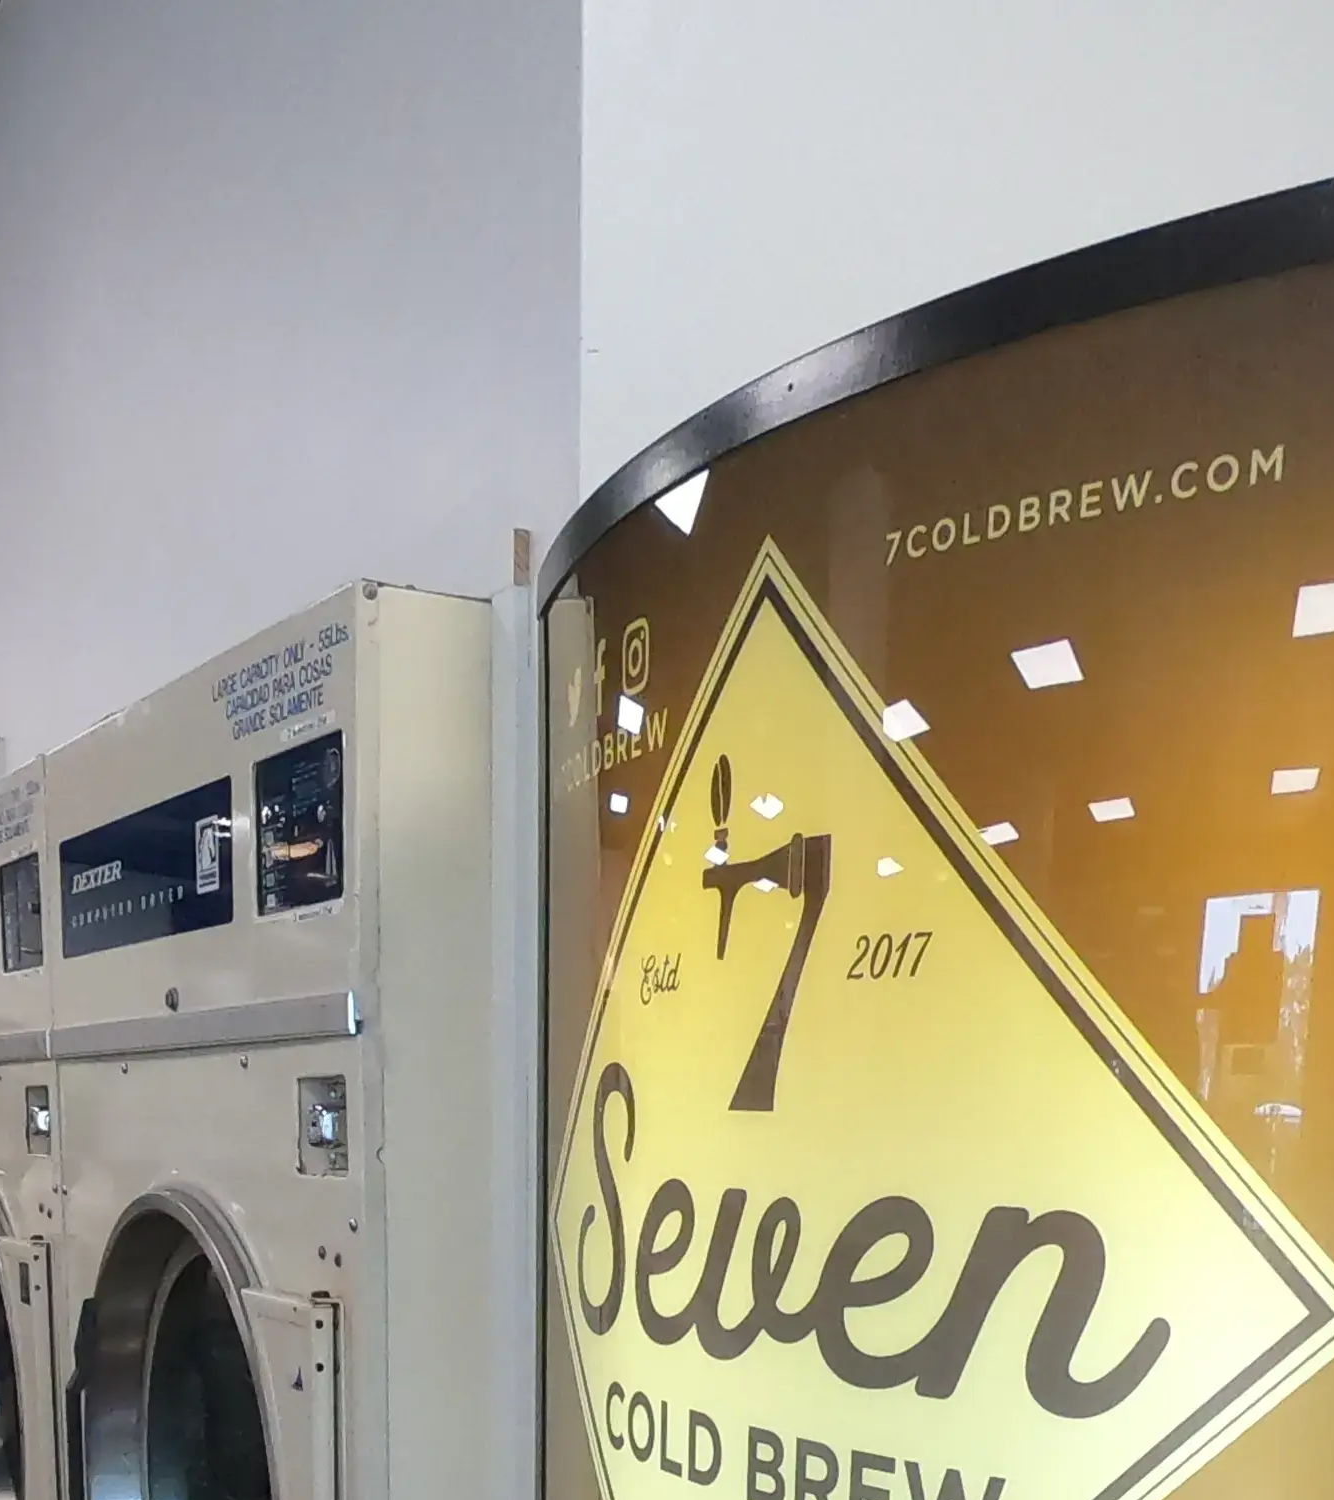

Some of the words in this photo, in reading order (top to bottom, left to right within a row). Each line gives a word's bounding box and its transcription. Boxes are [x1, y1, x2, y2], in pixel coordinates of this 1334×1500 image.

[884, 444, 1287, 567] 7COLDBREW.COM
[212, 672, 238, 702] LARGE
[240, 654, 280, 689] CAPACITY
[283, 640, 305, 669] ONLY
[272, 671, 296, 697] PARA
[299, 653, 333, 688] COSAS
[232, 708, 266, 740] GRANDE
[269, 683, 324, 726] SOLAMENTE
[70, 860, 123, 895] DEXTER
[846, 930, 934, 983] 2017
[578, 1062, 1173, 1421] Seven
[605, 1379, 723, 1489] COLD
